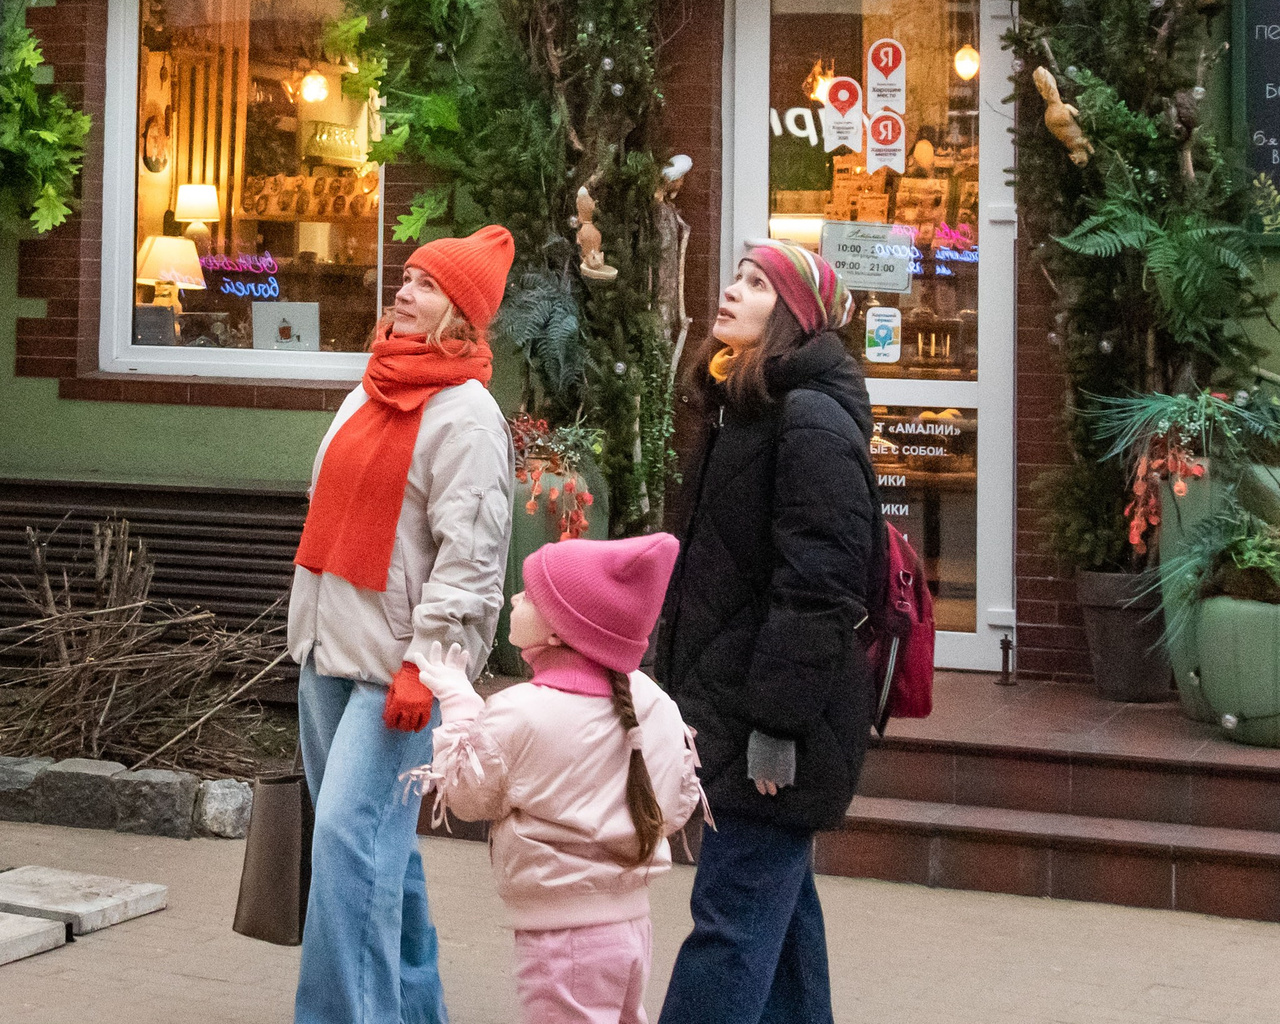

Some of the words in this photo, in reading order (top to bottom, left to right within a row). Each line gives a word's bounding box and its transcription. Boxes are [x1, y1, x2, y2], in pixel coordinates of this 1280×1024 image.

[880, 47, 893, 67] Я
[880, 120, 892, 140] Я
[837, 244, 861, 254] 10:00
[889, 423, 961, 436] «АМАЛИИ»
